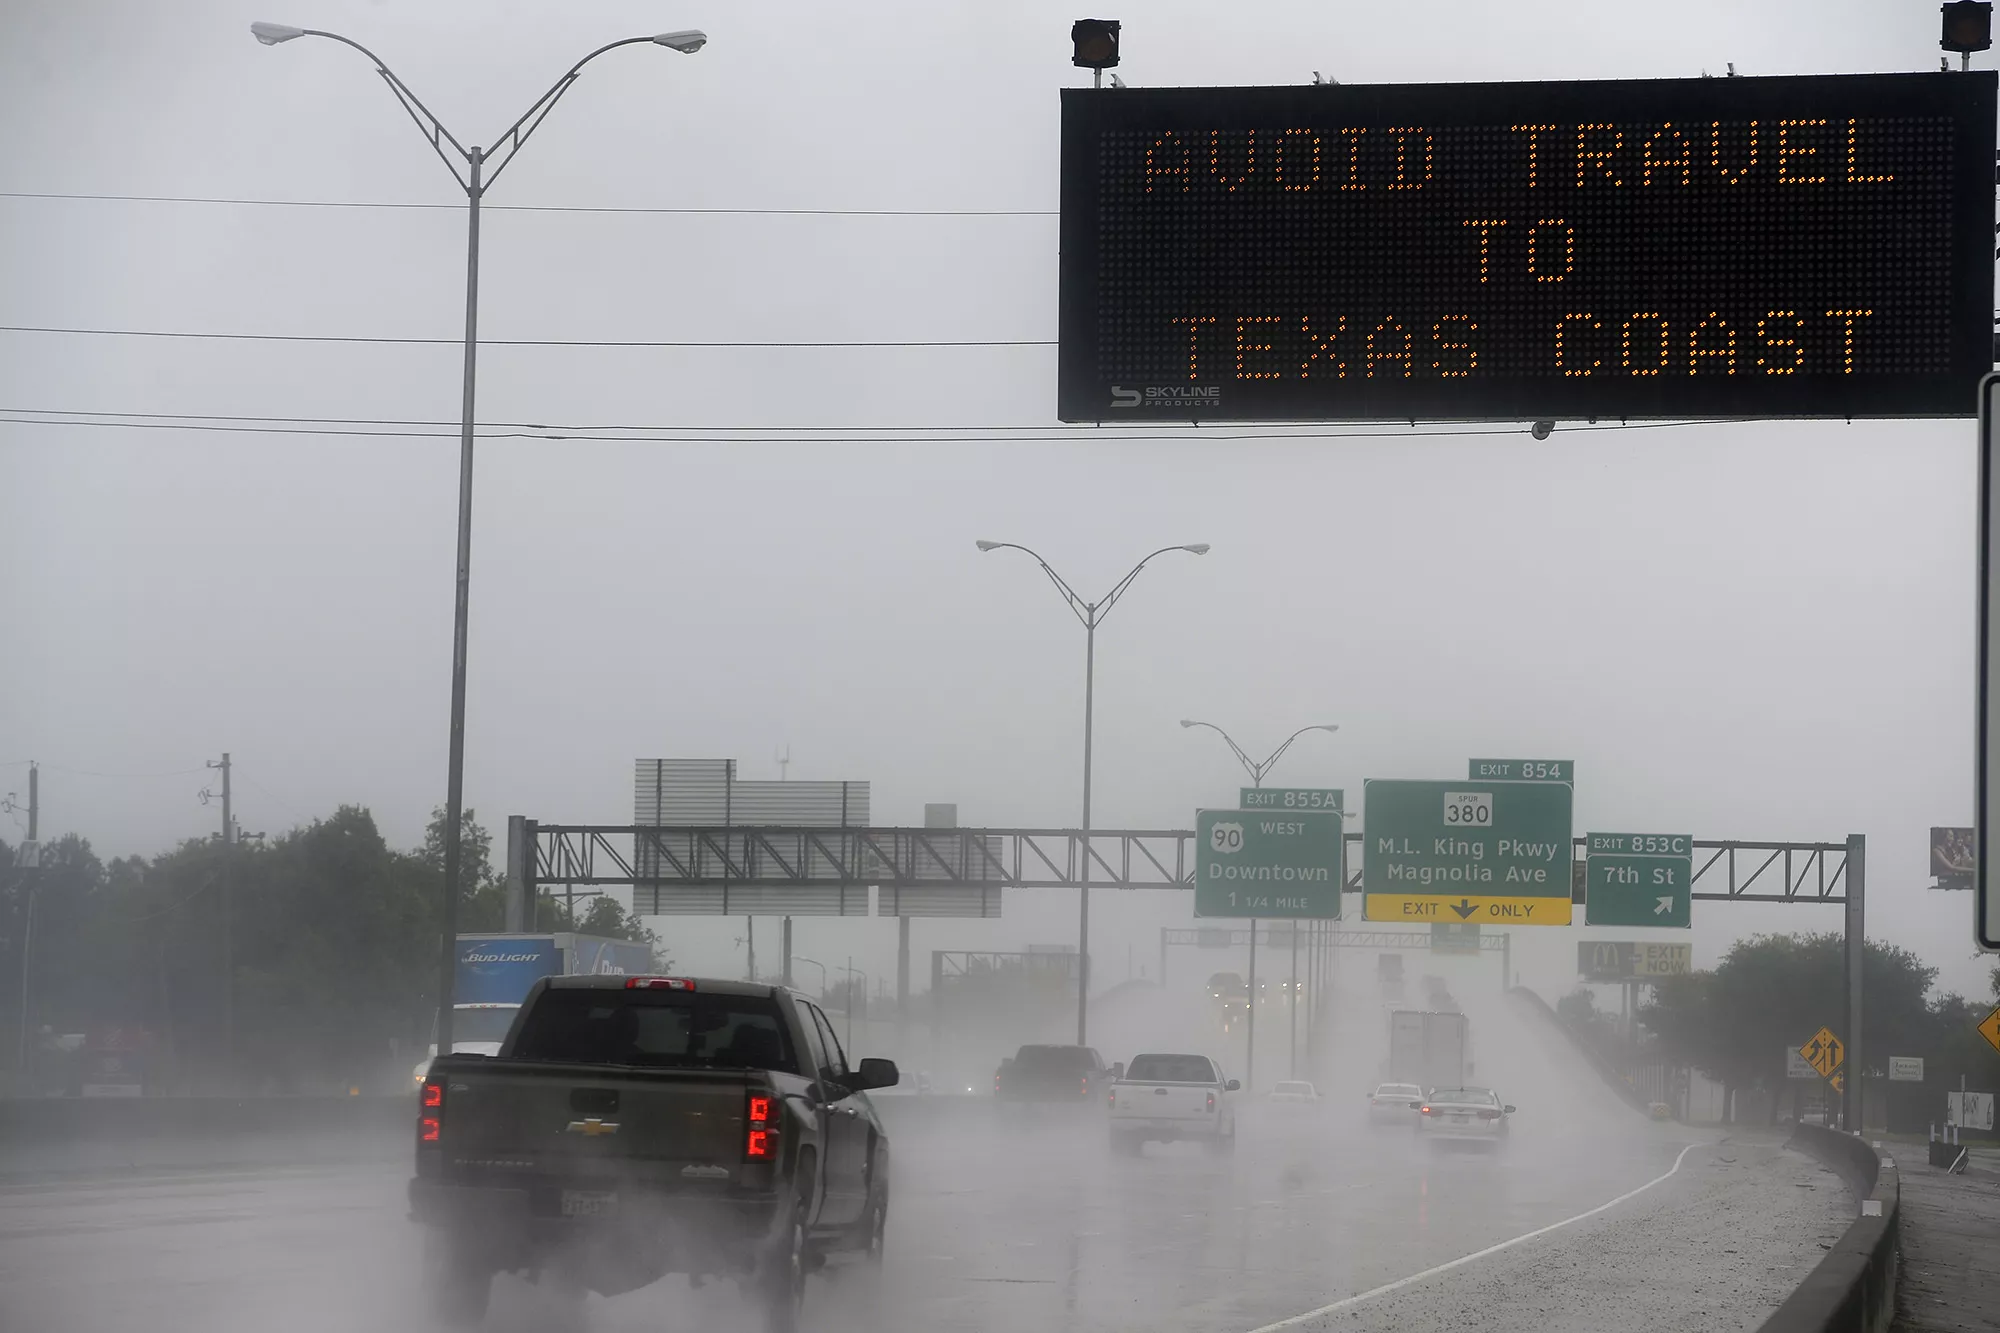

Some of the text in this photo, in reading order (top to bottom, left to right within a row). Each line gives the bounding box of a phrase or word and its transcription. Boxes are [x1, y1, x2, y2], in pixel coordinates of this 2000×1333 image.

[1145, 118, 1894, 192] AVOID TRAVEL
[1463, 218, 1575, 283] TO
[1172, 309, 1873, 379] TEXAS COAST
[1145, 386, 1220, 397] SKYLINE
[1480, 762, 1561, 778] EXIT 854
[1247, 792, 1337, 807] EXIT 855A
[1447, 804, 1489, 823] 380
[1260, 822, 1305, 835] WEST
[1214, 829, 1241, 847] 90
[1594, 836, 1684, 853] EXIT 853C
[1379, 837, 1558, 861] M.L. King Pkwy
[1209, 863, 1328, 881] Downtown
[1388, 863, 1547, 885] Magnolia Ave
[1603, 865, 1674, 885] 7th St
[1228, 892, 1309, 908] 1 1/4 MILE
[1403, 902, 1535, 917] EXIT ONLY
[1646, 945, 1686, 959] EXIT
[1646, 960, 1686, 973] NOW
